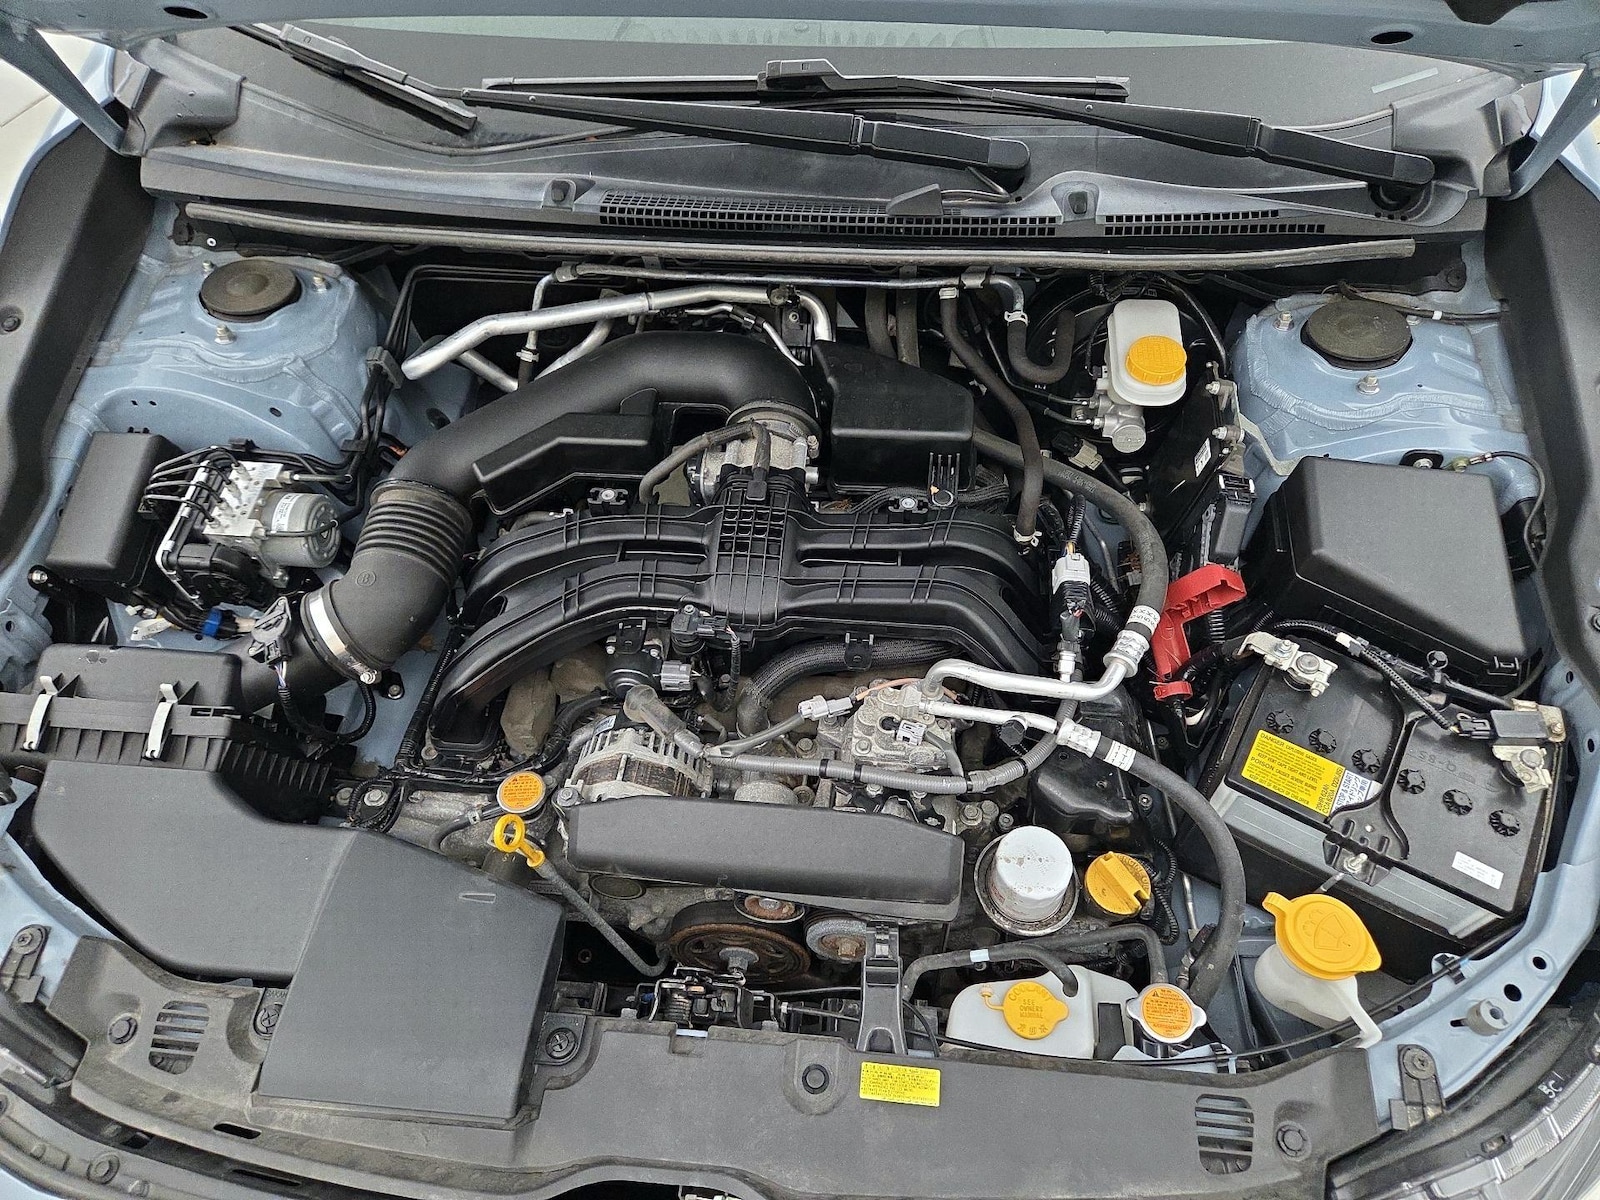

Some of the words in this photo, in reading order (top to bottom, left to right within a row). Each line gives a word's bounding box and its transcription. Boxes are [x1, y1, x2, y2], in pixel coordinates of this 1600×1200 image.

[1260, 733, 1284, 747] DANGER
[1250, 757, 1274, 771] POISON
[1341, 772, 1355, 789] START
[1335, 791, 1348, 807] STOP
